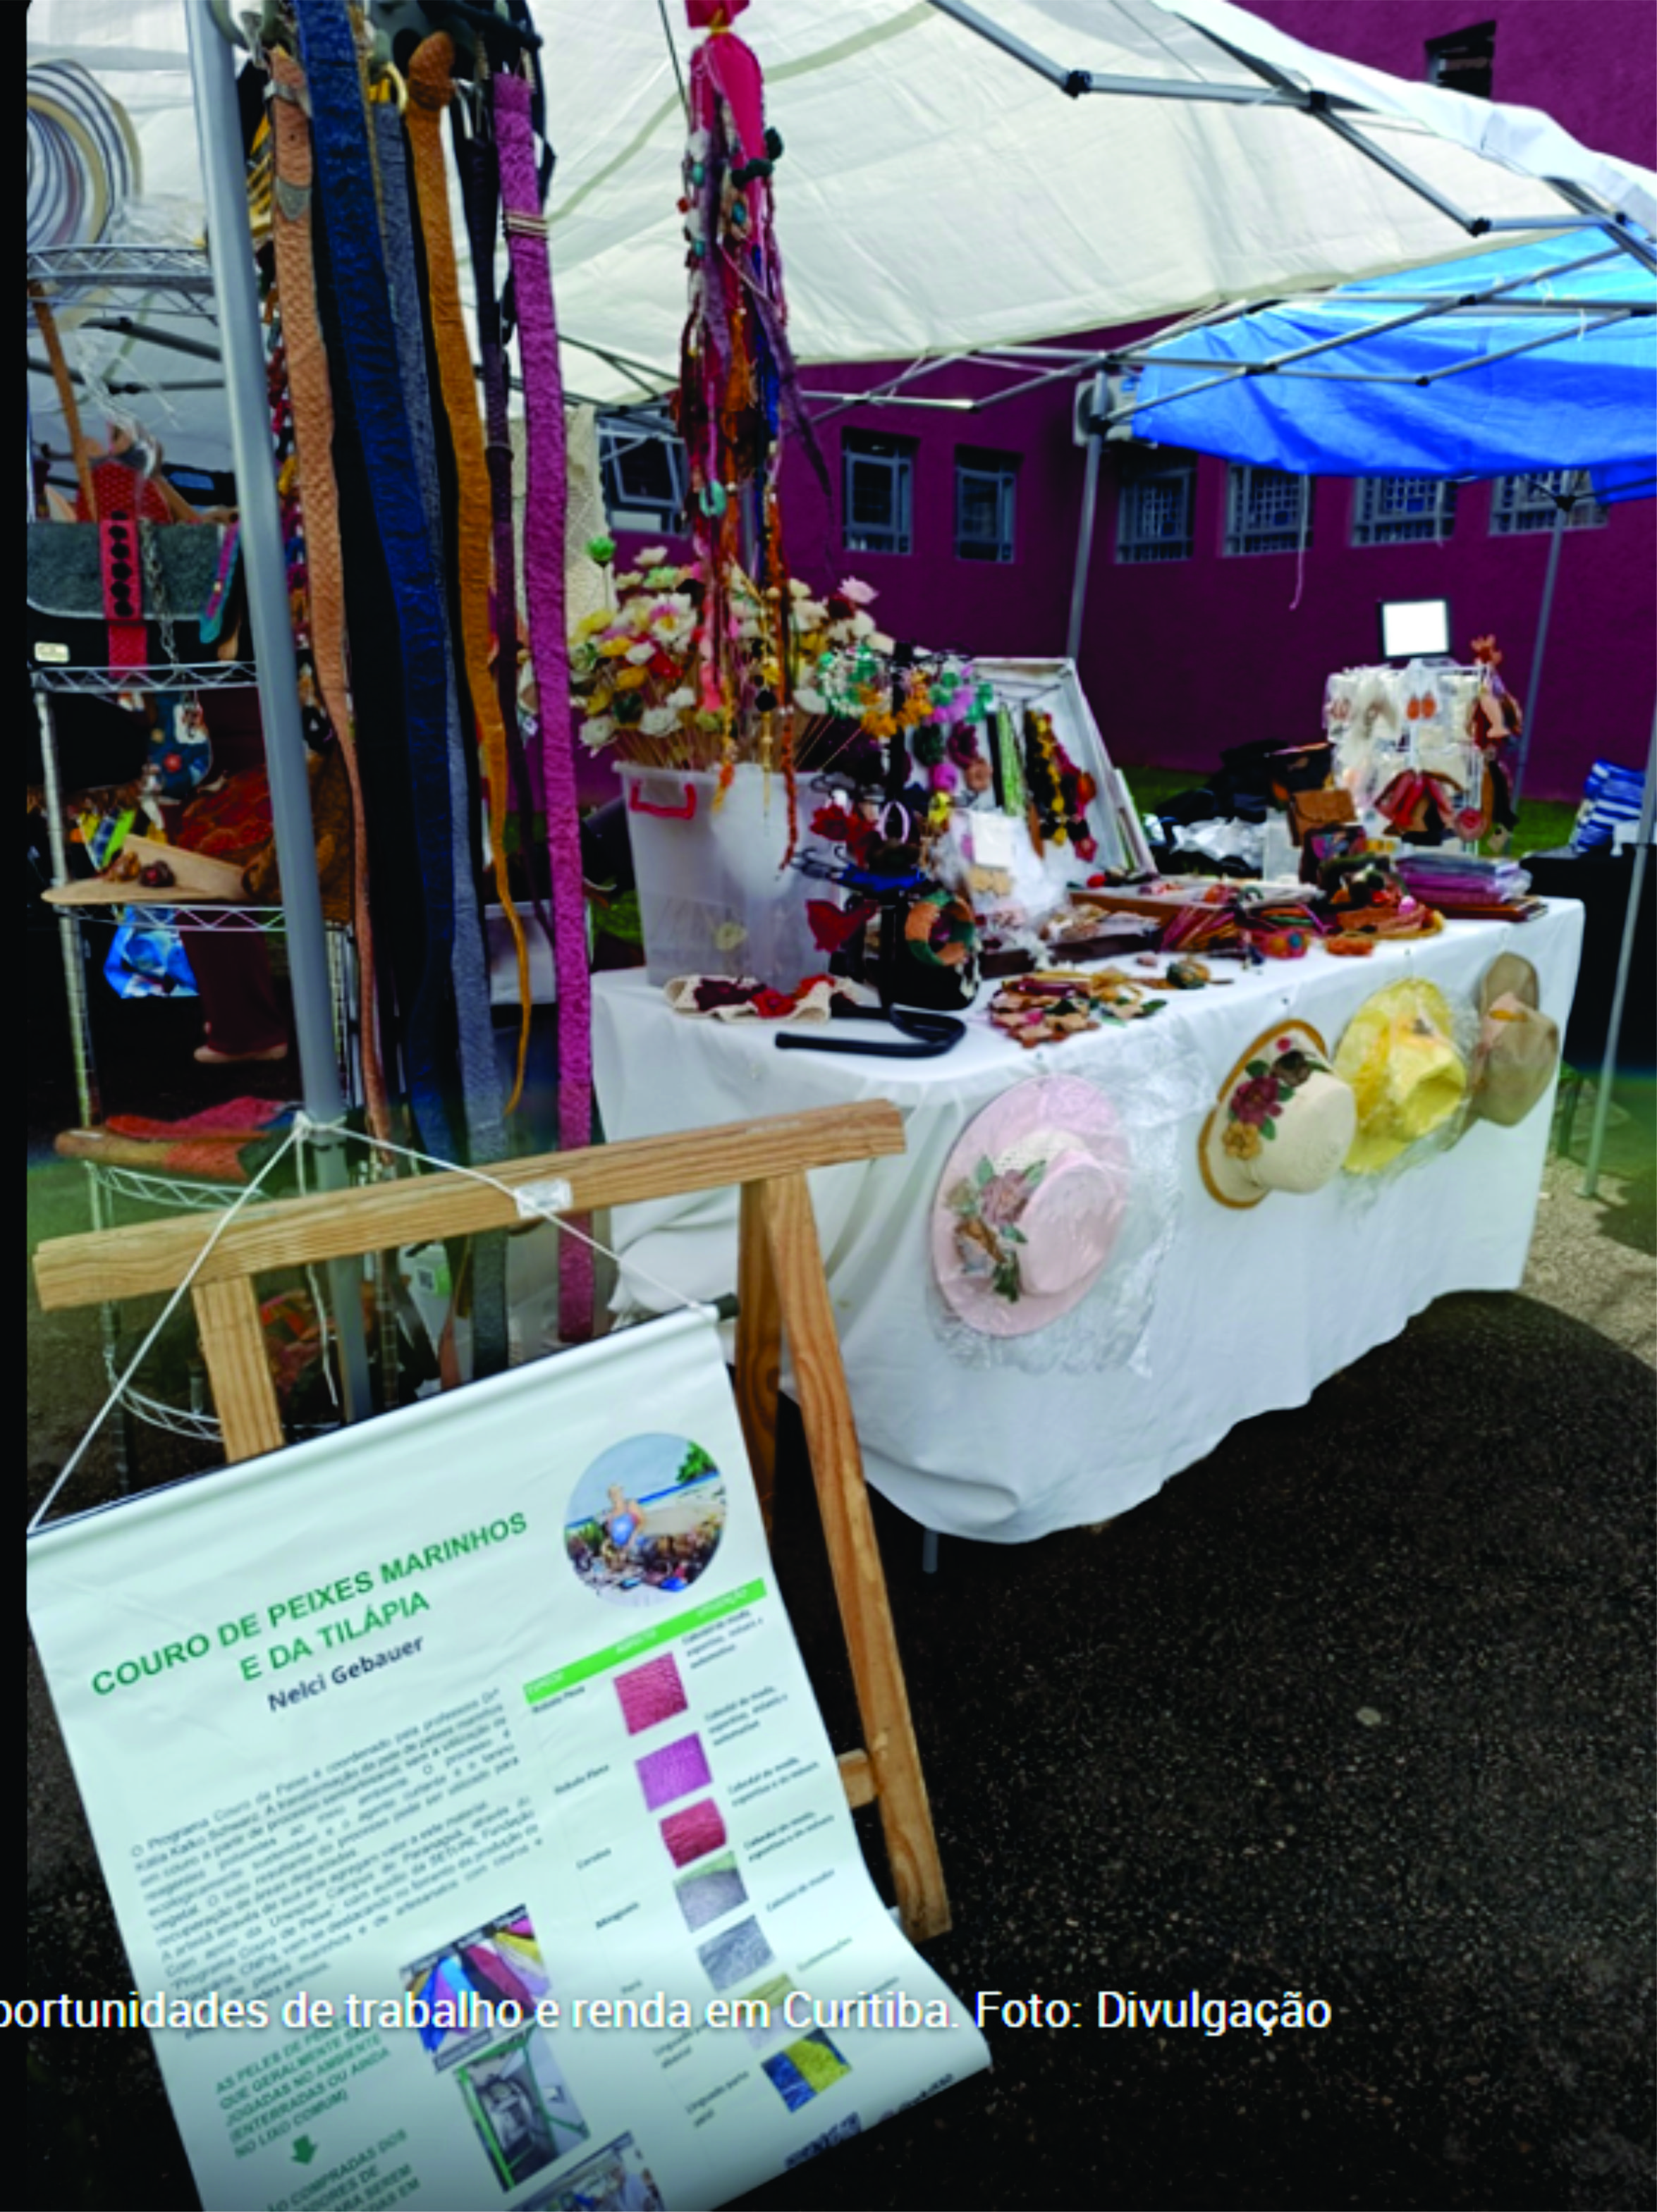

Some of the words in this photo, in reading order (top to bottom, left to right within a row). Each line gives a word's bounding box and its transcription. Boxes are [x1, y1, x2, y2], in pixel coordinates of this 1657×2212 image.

[91, 1633, 211, 1696] COURO
[218, 1614, 262, 1648] DE
[268, 1571, 375, 1630] PEIXES
[380, 1512, 529, 1585] MARINHOS
[239, 1656, 262, 1682] E
[269, 1641, 313, 1671] DA
[317, 1590, 430, 1651] TILÁPIA
[267, 1676, 326, 1713] Nelci
[331, 1635, 425, 1687] Gebauer
